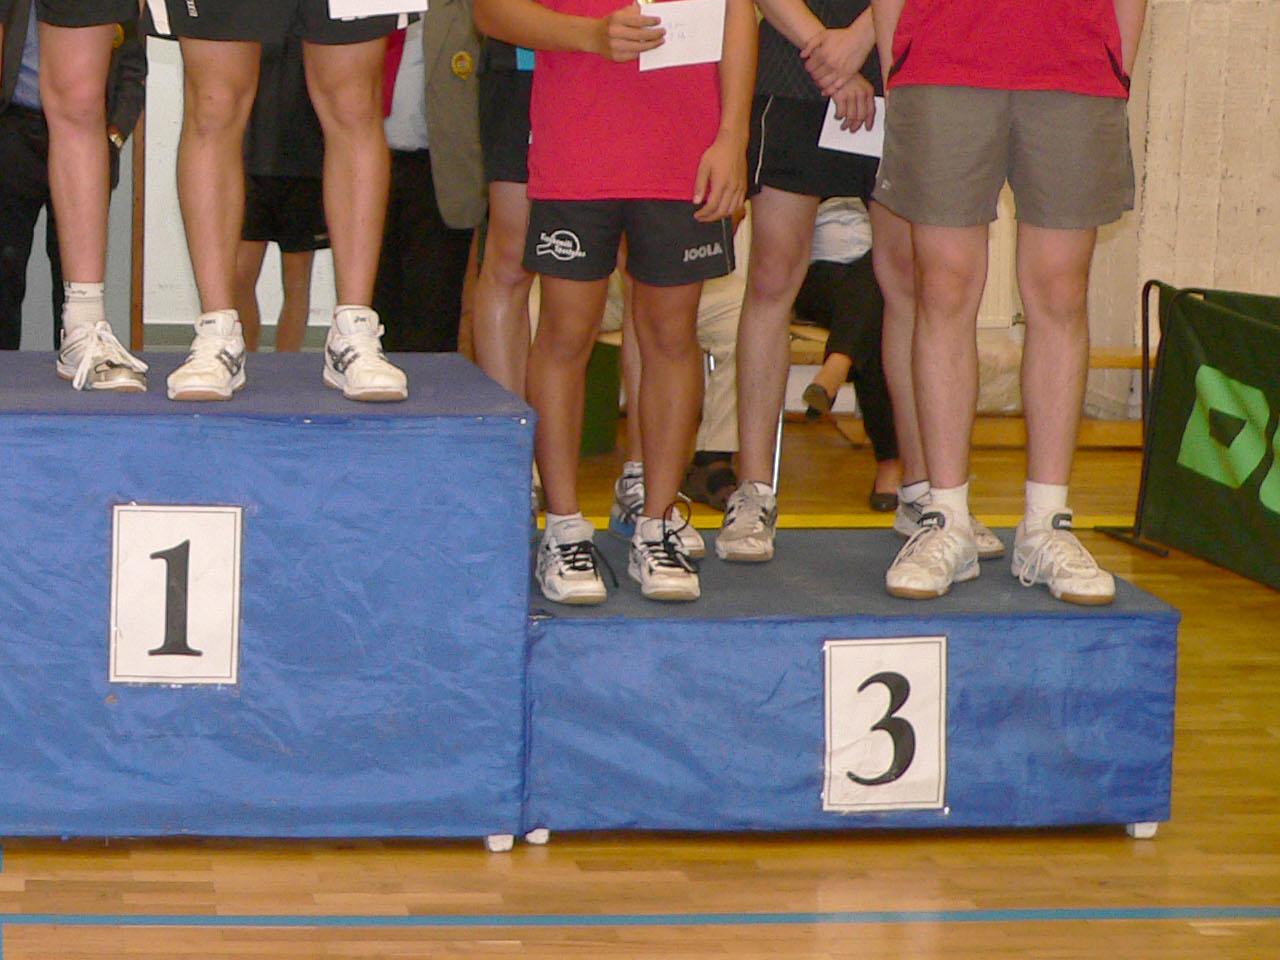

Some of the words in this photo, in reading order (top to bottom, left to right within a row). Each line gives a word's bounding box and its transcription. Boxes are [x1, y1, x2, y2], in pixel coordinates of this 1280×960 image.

[683, 242, 723, 262] JOOLA
[148, 539, 203, 657] 1
[846, 671, 916, 787] 3
